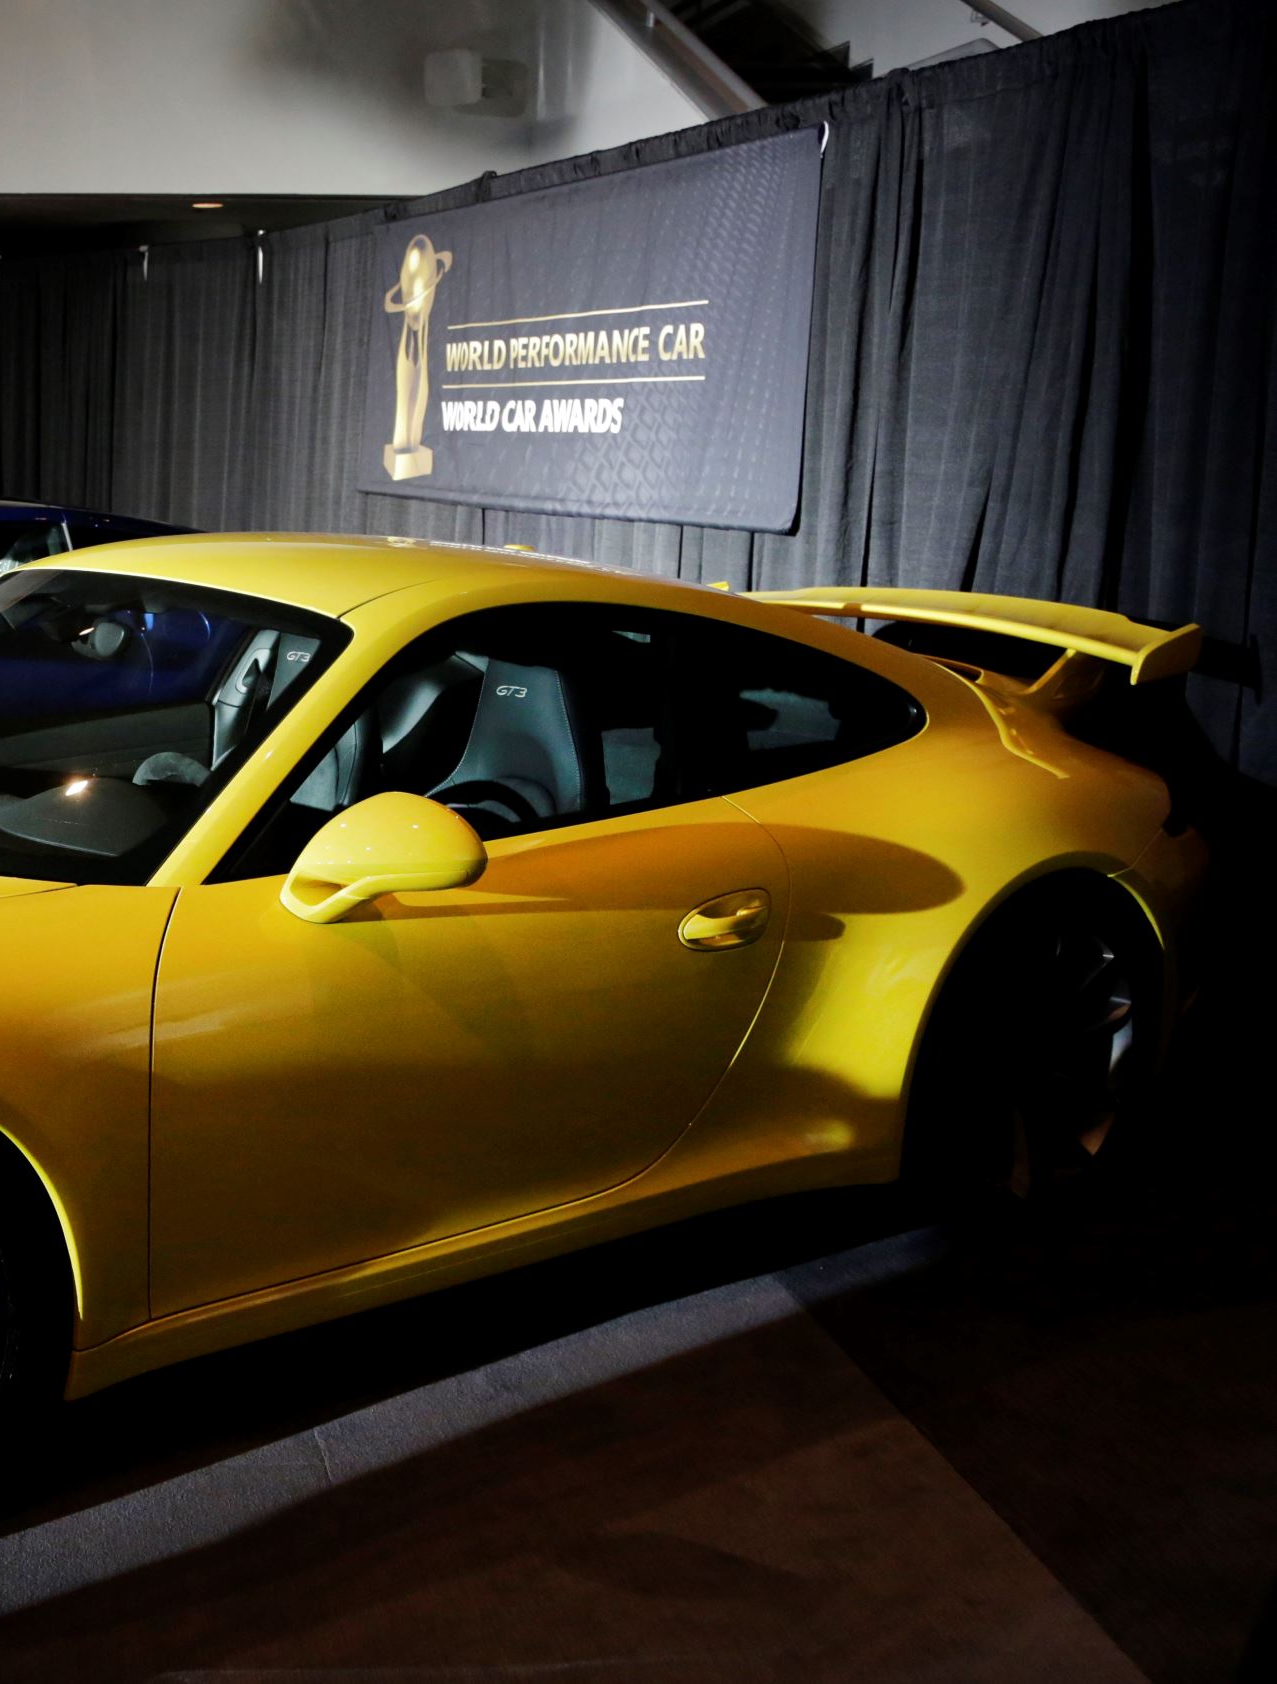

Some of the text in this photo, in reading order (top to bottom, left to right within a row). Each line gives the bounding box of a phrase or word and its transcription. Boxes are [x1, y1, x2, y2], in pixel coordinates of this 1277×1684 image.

[446, 323, 706, 372] WORLD PERFORMANCE CAR
[441, 398, 624, 434] WORLD CAR AWARDS
[286, 651, 311, 663] GT3
[496, 685, 528, 698] GT3
